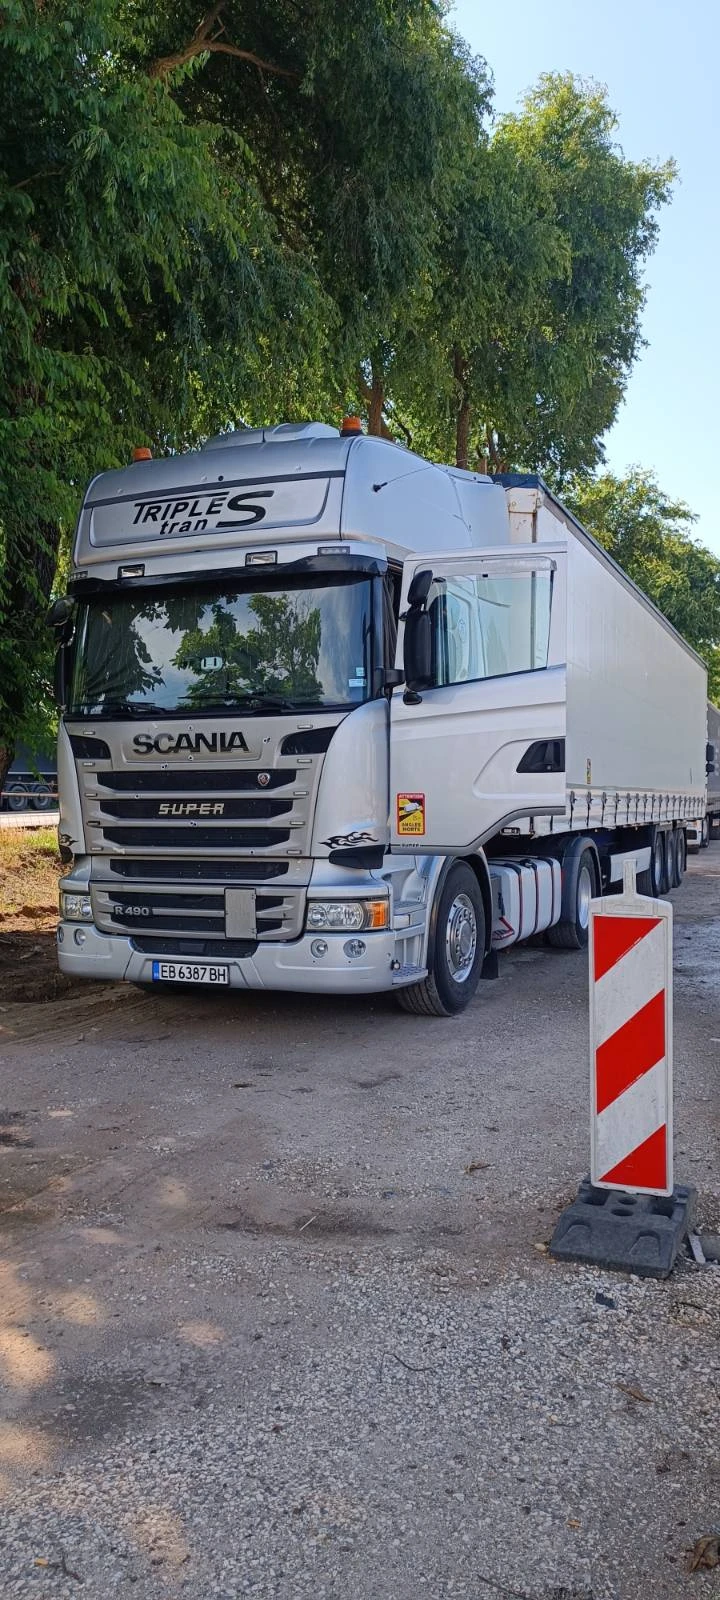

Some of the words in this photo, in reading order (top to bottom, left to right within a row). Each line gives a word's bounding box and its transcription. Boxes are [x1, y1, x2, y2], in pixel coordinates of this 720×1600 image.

[132, 491, 229, 524] TRIPLE
[215, 490, 274, 528] S
[160, 518, 208, 535] tran
[133, 731, 249, 754] SCANIA
[158, 803, 225, 815] SUPER
[115, 906, 124, 915] R
[125, 906, 149, 916] 490
[161, 965, 176, 979] EB
[178, 966, 207, 981] 6387
[209, 968, 226, 982] BH
